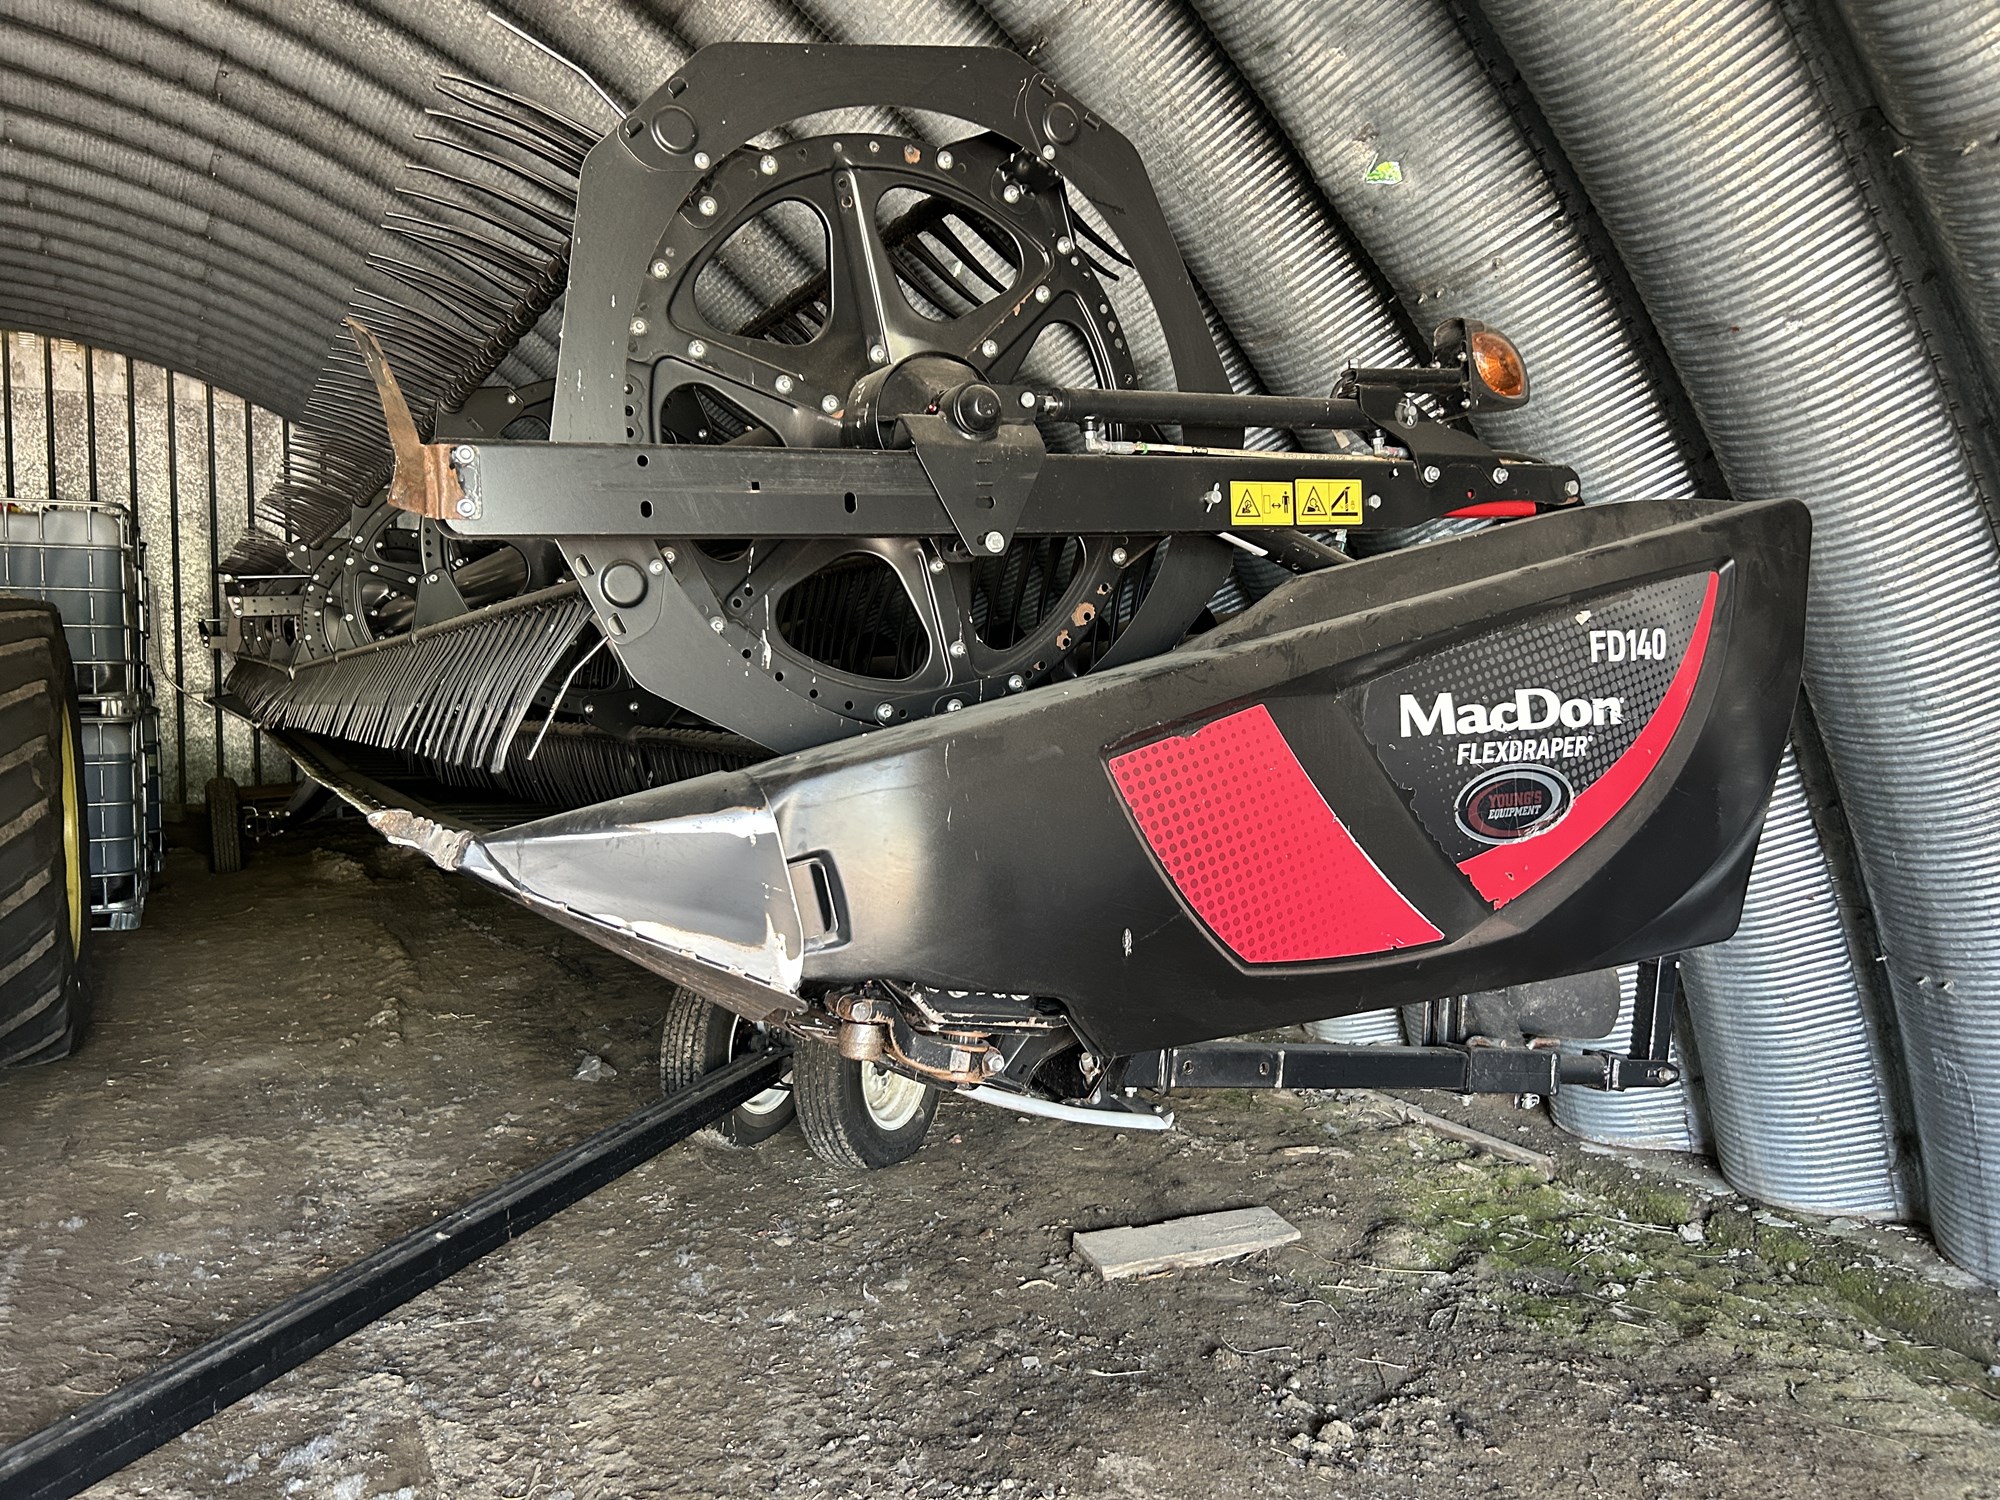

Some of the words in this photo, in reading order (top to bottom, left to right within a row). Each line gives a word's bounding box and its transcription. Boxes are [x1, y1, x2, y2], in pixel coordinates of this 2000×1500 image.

[1589, 628, 1667, 663] FD140
[1400, 688, 1623, 737] MacDon
[1457, 735, 1590, 765] FLEXDRAPER
[1487, 805, 1542, 820] EQUIPMENT
[1488, 790, 1543, 809] YOUNG'S
